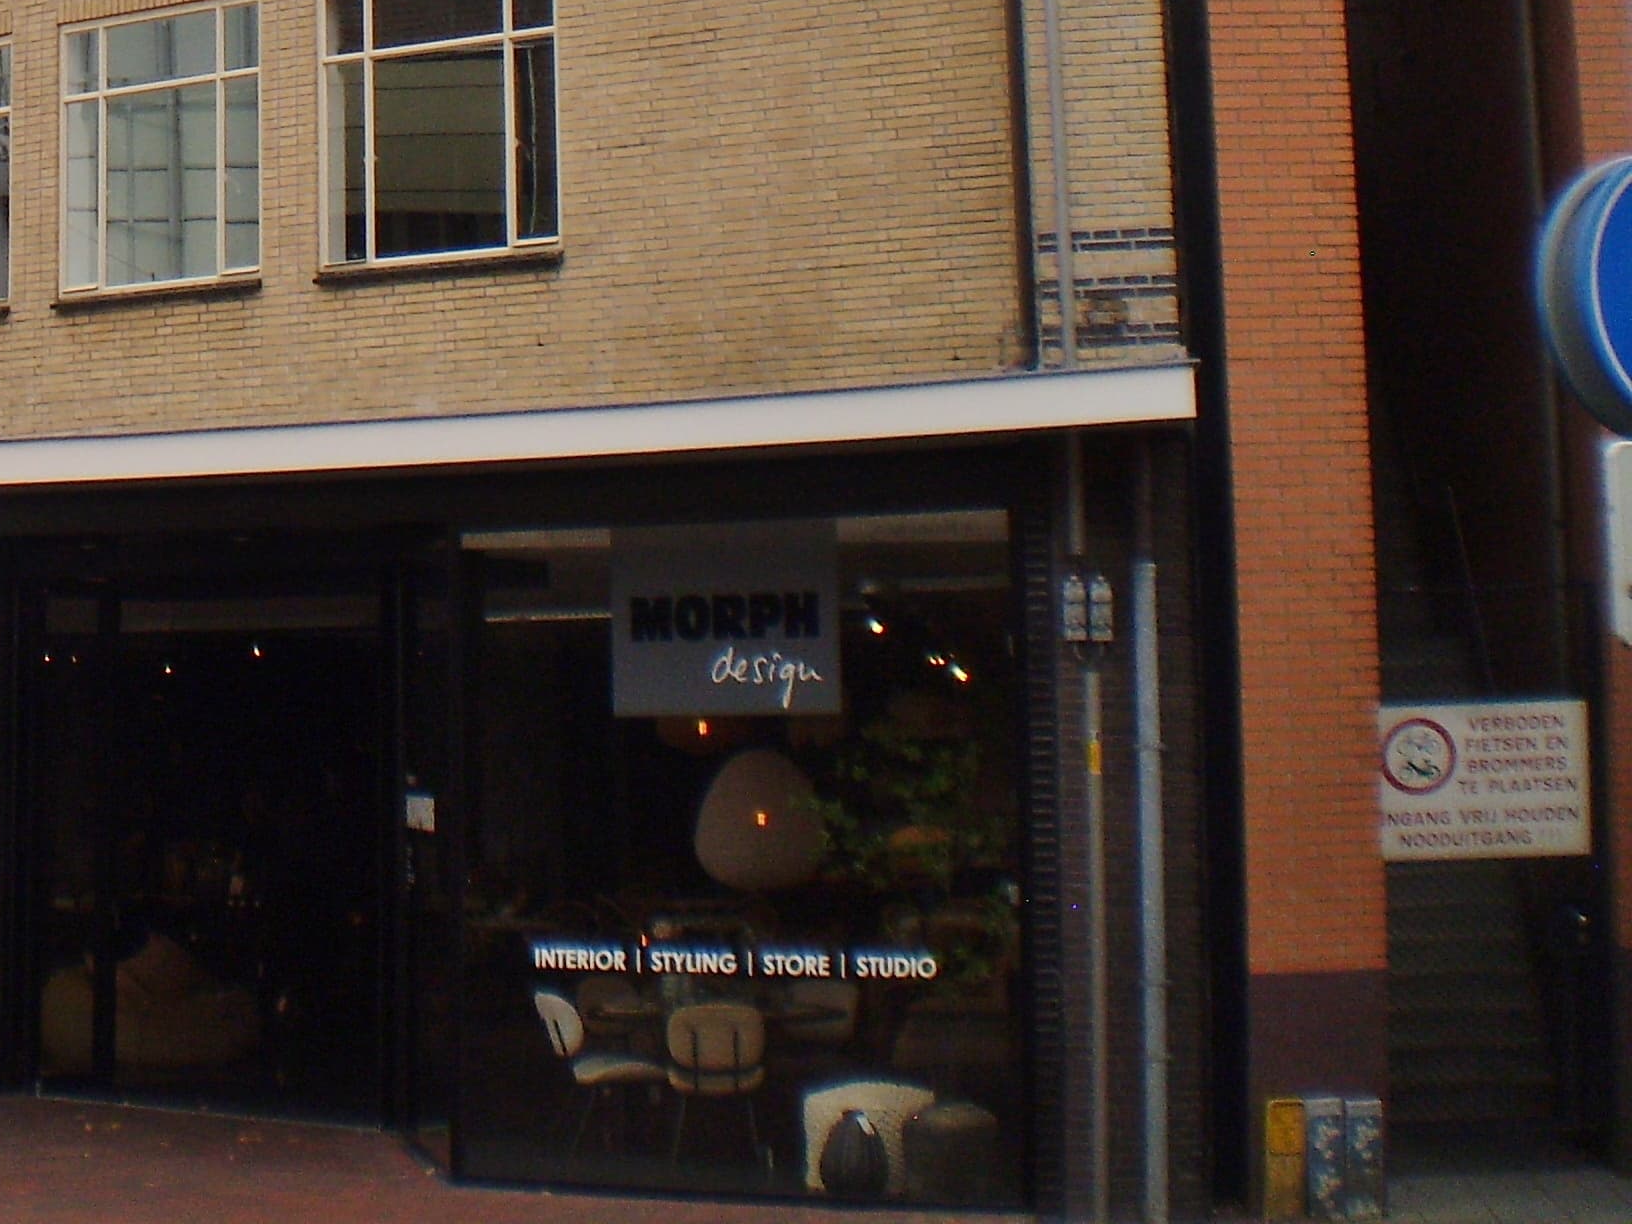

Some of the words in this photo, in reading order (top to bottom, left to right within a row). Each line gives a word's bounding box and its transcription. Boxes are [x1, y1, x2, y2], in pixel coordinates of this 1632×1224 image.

[630, 593, 819, 641] MORPH
[711, 646, 824, 710] design
[1469, 714, 1565, 732] VERBODEN
[1465, 736, 1537, 753] FIETSEN
[1545, 735, 1569, 751] EN
[1467, 756, 1568, 773] BROMMERS
[1458, 779, 1478, 795] TE
[1488, 776, 1579, 794] PLAATSEN
[1382, 810, 1451, 827] NGANG
[1504, 805, 1580, 823] HOUDEN
[1399, 829, 1532, 849] NOODUITGANG
[534, 947, 627, 971] INTERIOR
[650, 950, 738, 975] STYLING
[762, 954, 831, 976] STORE
[856, 956, 937, 978] STUDIO
